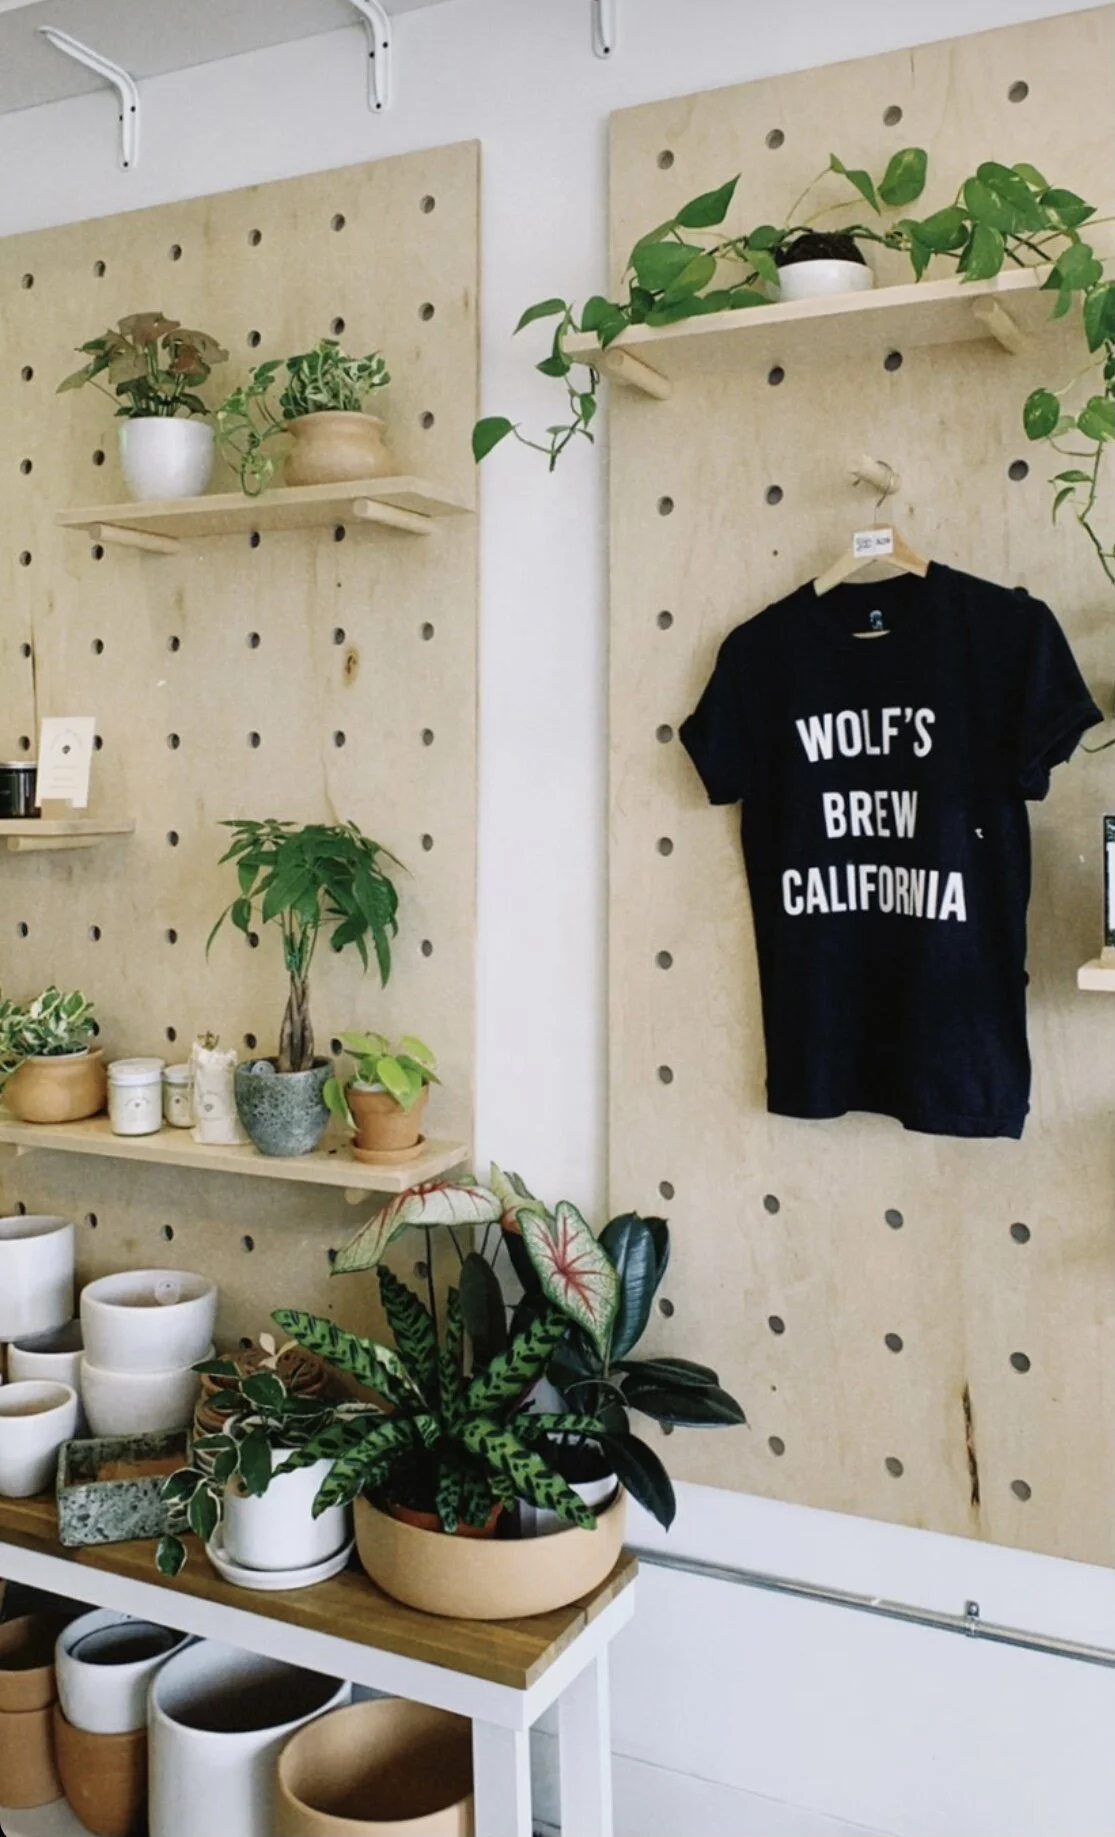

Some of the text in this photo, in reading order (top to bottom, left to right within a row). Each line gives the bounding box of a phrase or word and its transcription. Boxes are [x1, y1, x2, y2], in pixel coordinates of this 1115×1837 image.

[795, 707, 936, 763] WOLF'S
[822, 790, 918, 839] BREW
[782, 863, 967, 922] CALIFORNIA
